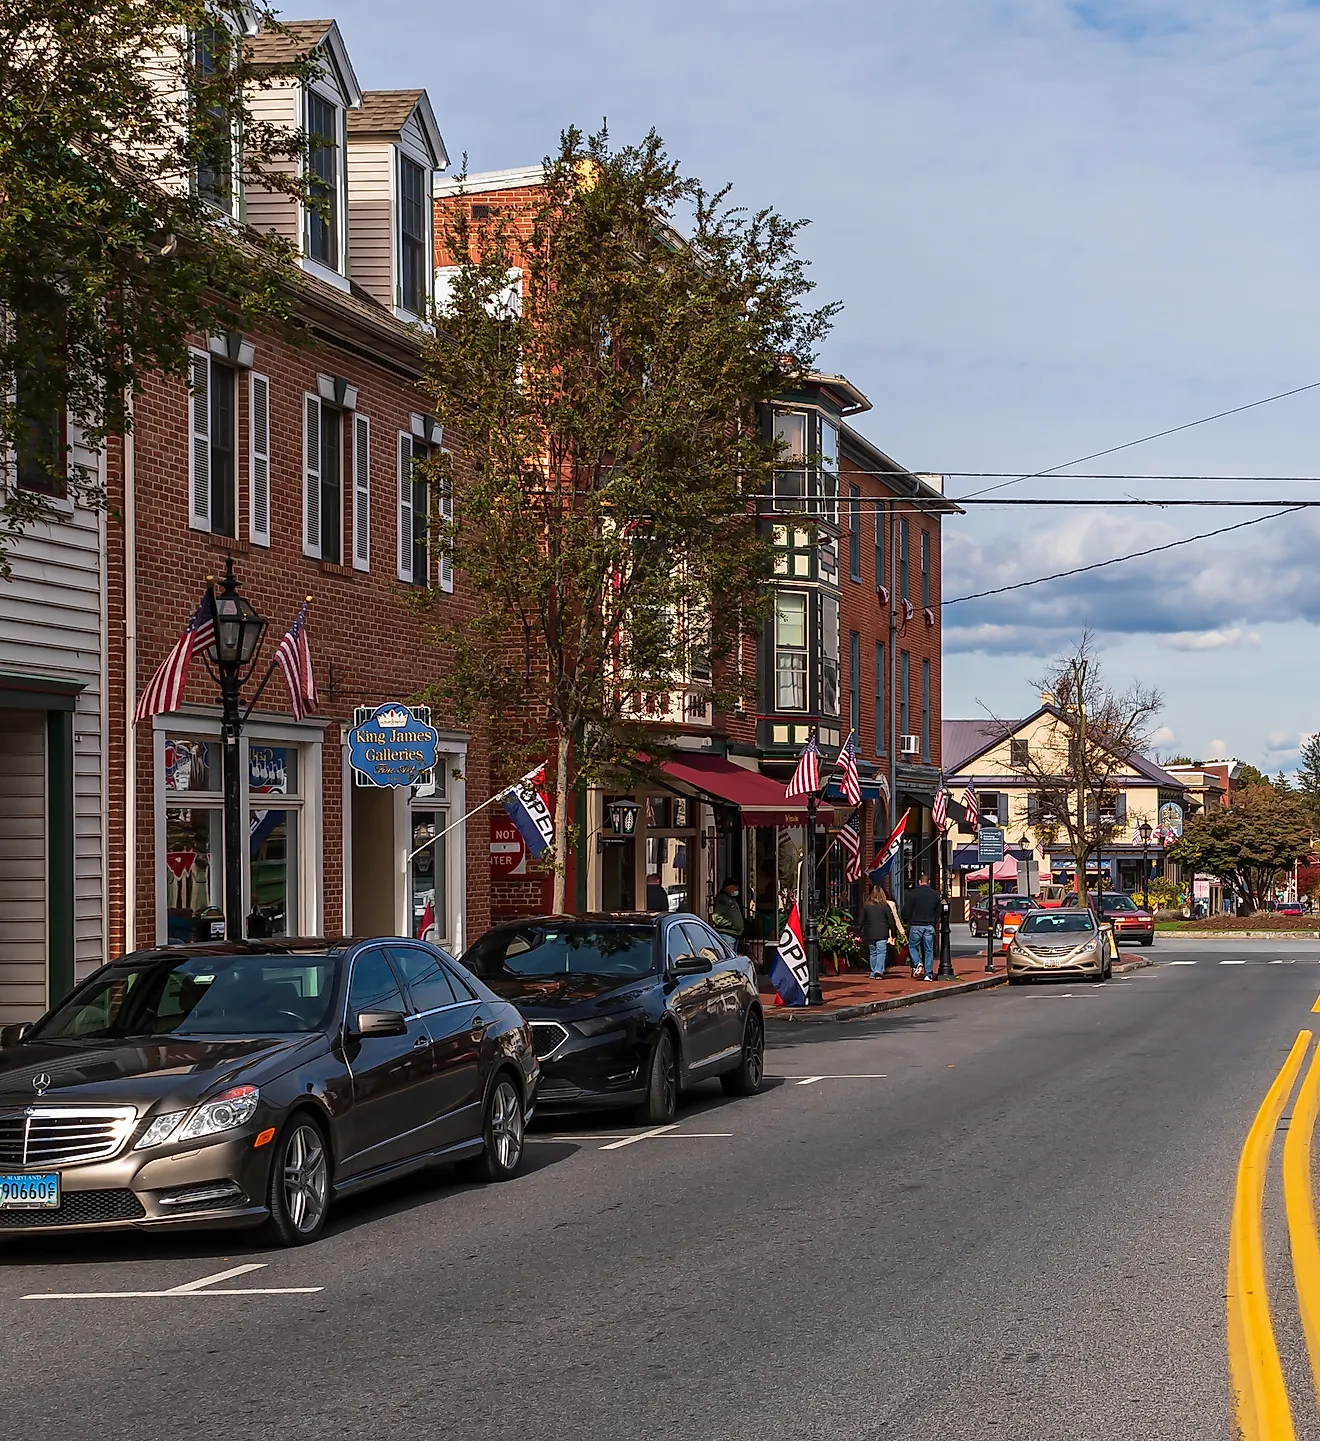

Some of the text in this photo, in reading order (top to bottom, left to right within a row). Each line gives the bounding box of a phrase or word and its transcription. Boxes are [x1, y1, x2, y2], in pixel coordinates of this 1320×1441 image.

[356, 729, 432, 745] King James
[365, 748, 424, 762] Galleries
[520, 788, 554, 837] OPE
[495, 830, 516, 839] NOT
[2, 1182, 46, 1200] 90660
